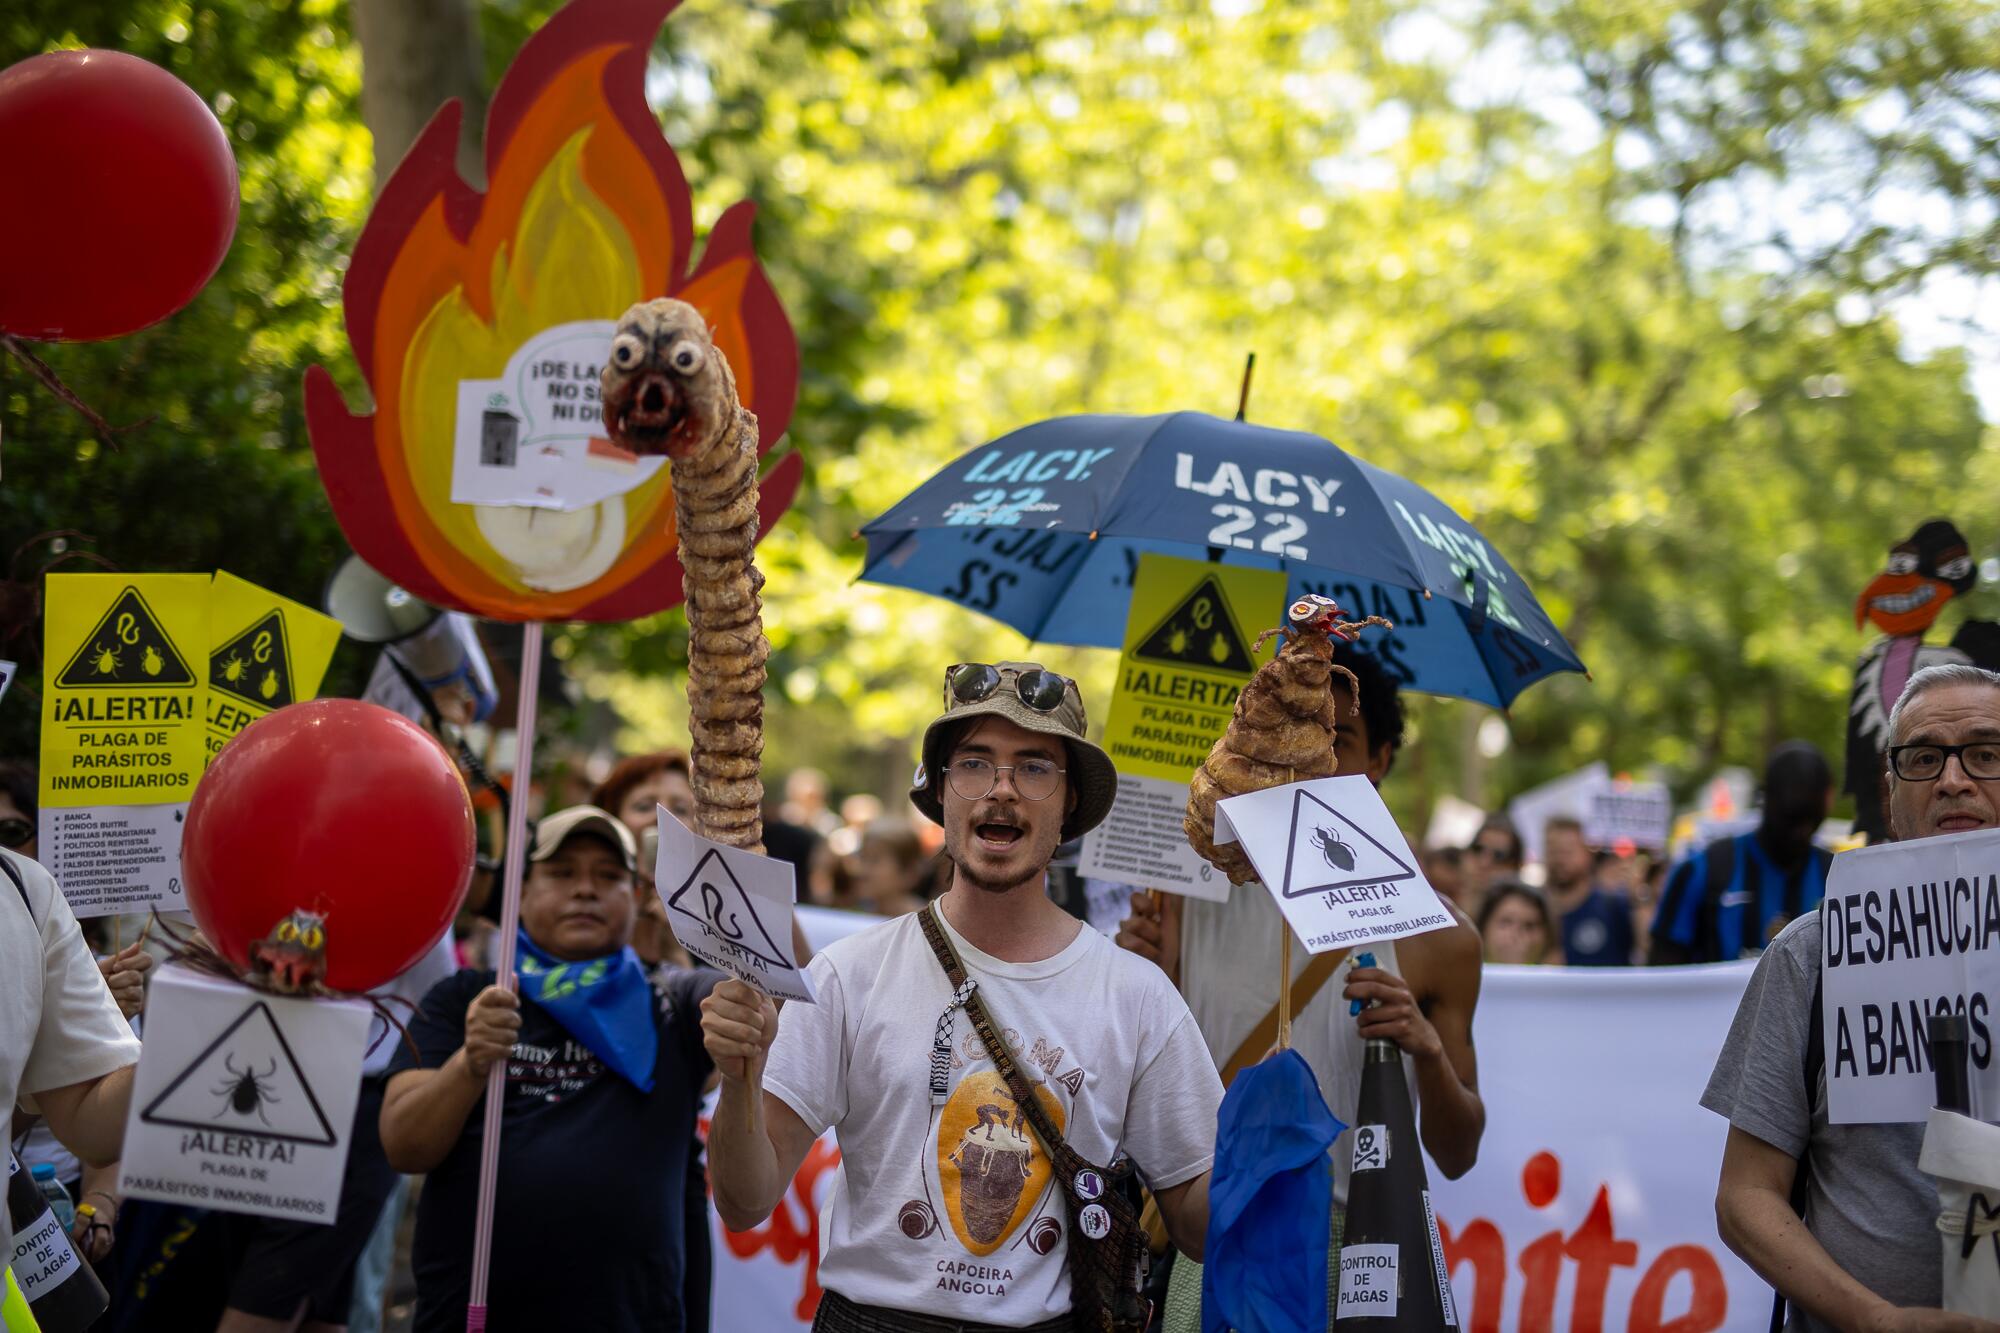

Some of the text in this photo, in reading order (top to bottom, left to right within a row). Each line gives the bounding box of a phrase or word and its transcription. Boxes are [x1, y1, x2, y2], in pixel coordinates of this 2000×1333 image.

[572, 363, 599, 381] LA
[547, 383, 579, 400] NO
[552, 403, 575, 421] NI
[1175, 452, 1346, 517] LACY,
[1208, 503, 1308, 561] 22
[1124, 669, 1240, 707] ¡ALERTA
[54, 696, 193, 721] ¡ALERTA!
[1142, 706, 1222, 731] PLAGA DE
[79, 731, 168, 747] PLAGA DE
[72, 750, 172, 768] PARÁSITOS
[1111, 741, 1206, 768] INMOBILIAR
[52, 772, 189, 790] INMOBILIARIOS
[64, 813, 92, 821] BANCA
[63, 828, 156, 840] FAMILIAS PARASITARIAS
[64, 822, 98, 831] FONDOS
[108, 838, 149, 847] RENTISTAS
[63, 850, 107, 860] EMPRESAS
[63, 856, 166, 869] FALSOS EMPRENDEDORES
[63, 867, 140, 878] HEREDEROS VAGOS
[63, 878, 127, 888] INVERSIONISTAS
[103, 885, 150, 895] TENEDORES
[104, 893, 163, 904] INMOBILIARIAS
[1322, 882, 1400, 910] ¡ALERTA!
[1348, 905, 1395, 919] PLAGA DE
[1827, 874, 2000, 968] DESAHUCIA
[1307, 914, 1447, 947] PARÁSITOS INMOBILIARIOS
[1834, 992, 1991, 1078] A BANS
[181, 1132, 296, 1164] ¡ALERTA!
[201, 1161, 268, 1182] PLAGA DE
[123, 1176, 326, 1214] PARÁSITOS INMOBILIARIOS
[36, 1244, 55, 1263] DE
[25, 1249, 72, 1288] PLAGAS
[937, 1260, 1013, 1280] CAPOEIRA
[1341, 1256, 1396, 1271] CONTROL
[936, 1277, 1005, 1296] ANGOLA
[1354, 1273, 1370, 1286] DE
[1341, 1290, 1388, 1304] PLAGAS
